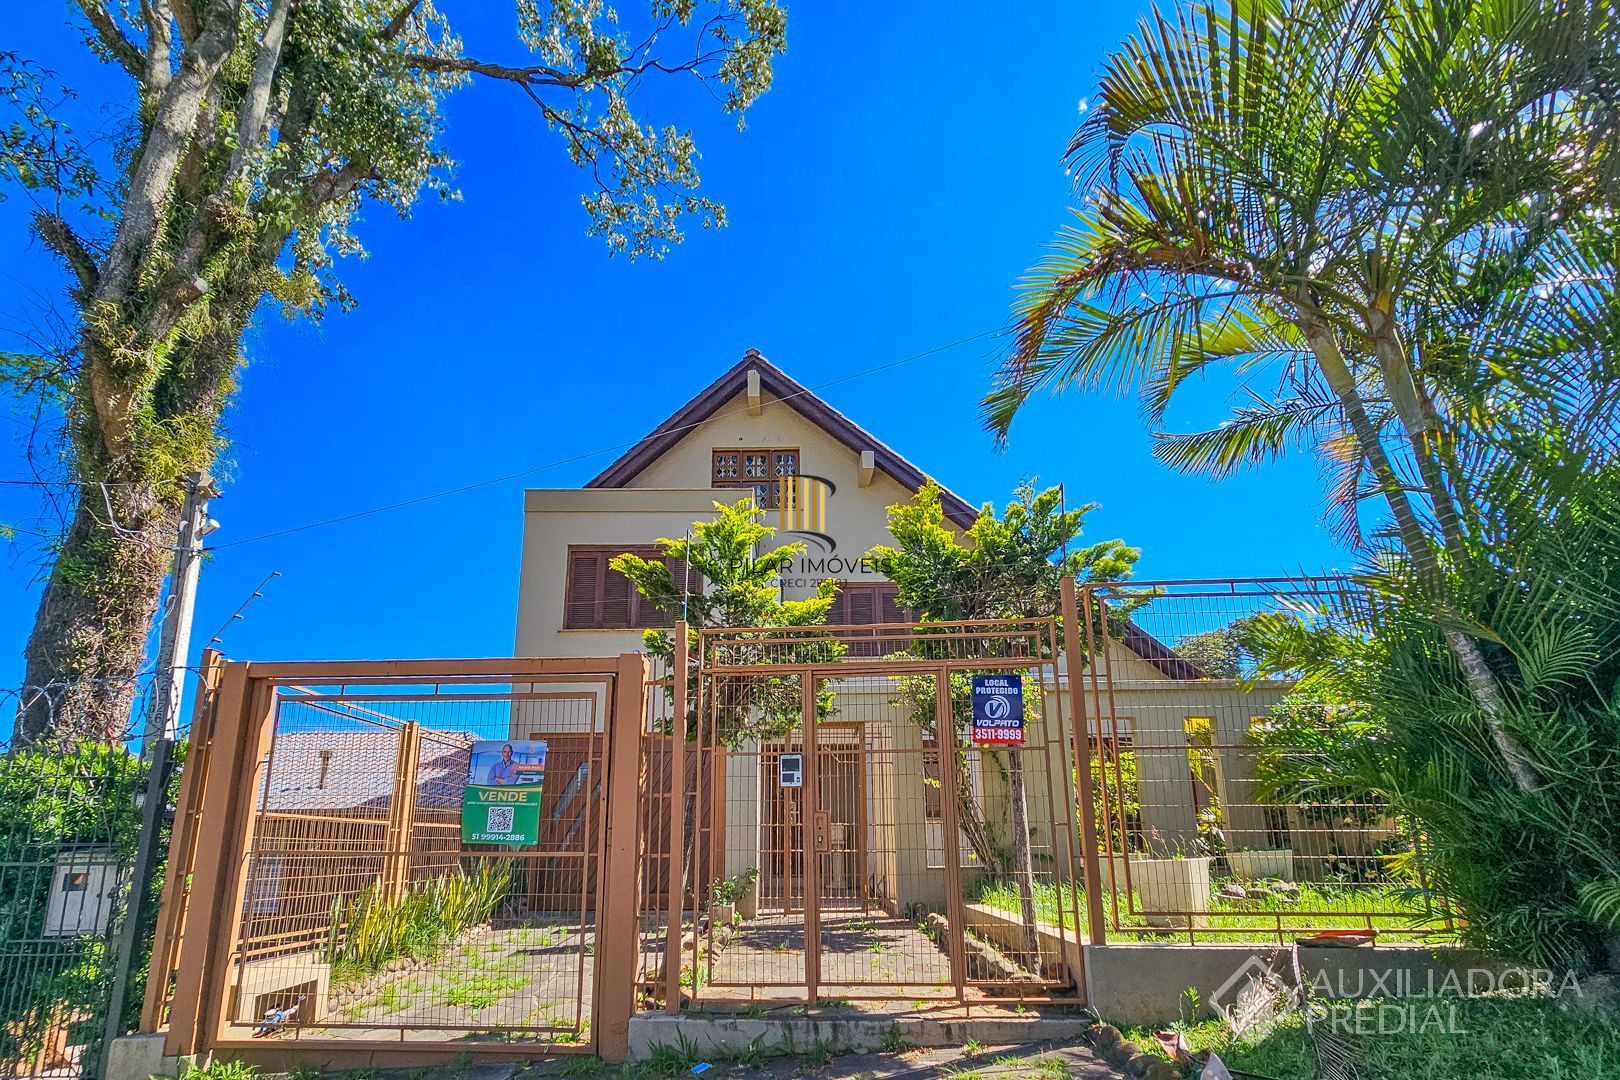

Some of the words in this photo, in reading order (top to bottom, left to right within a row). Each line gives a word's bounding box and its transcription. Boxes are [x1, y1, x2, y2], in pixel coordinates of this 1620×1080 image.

[984, 679, 1009, 687] LOCAL
[975, 687, 1019, 695] PROTEGIDO
[976, 719, 1020, 727] VOLPATO
[975, 729, 1022, 740] 3511-9999
[478, 791, 528, 802] VENDE
[481, 833, 525, 841] 99914-2886
